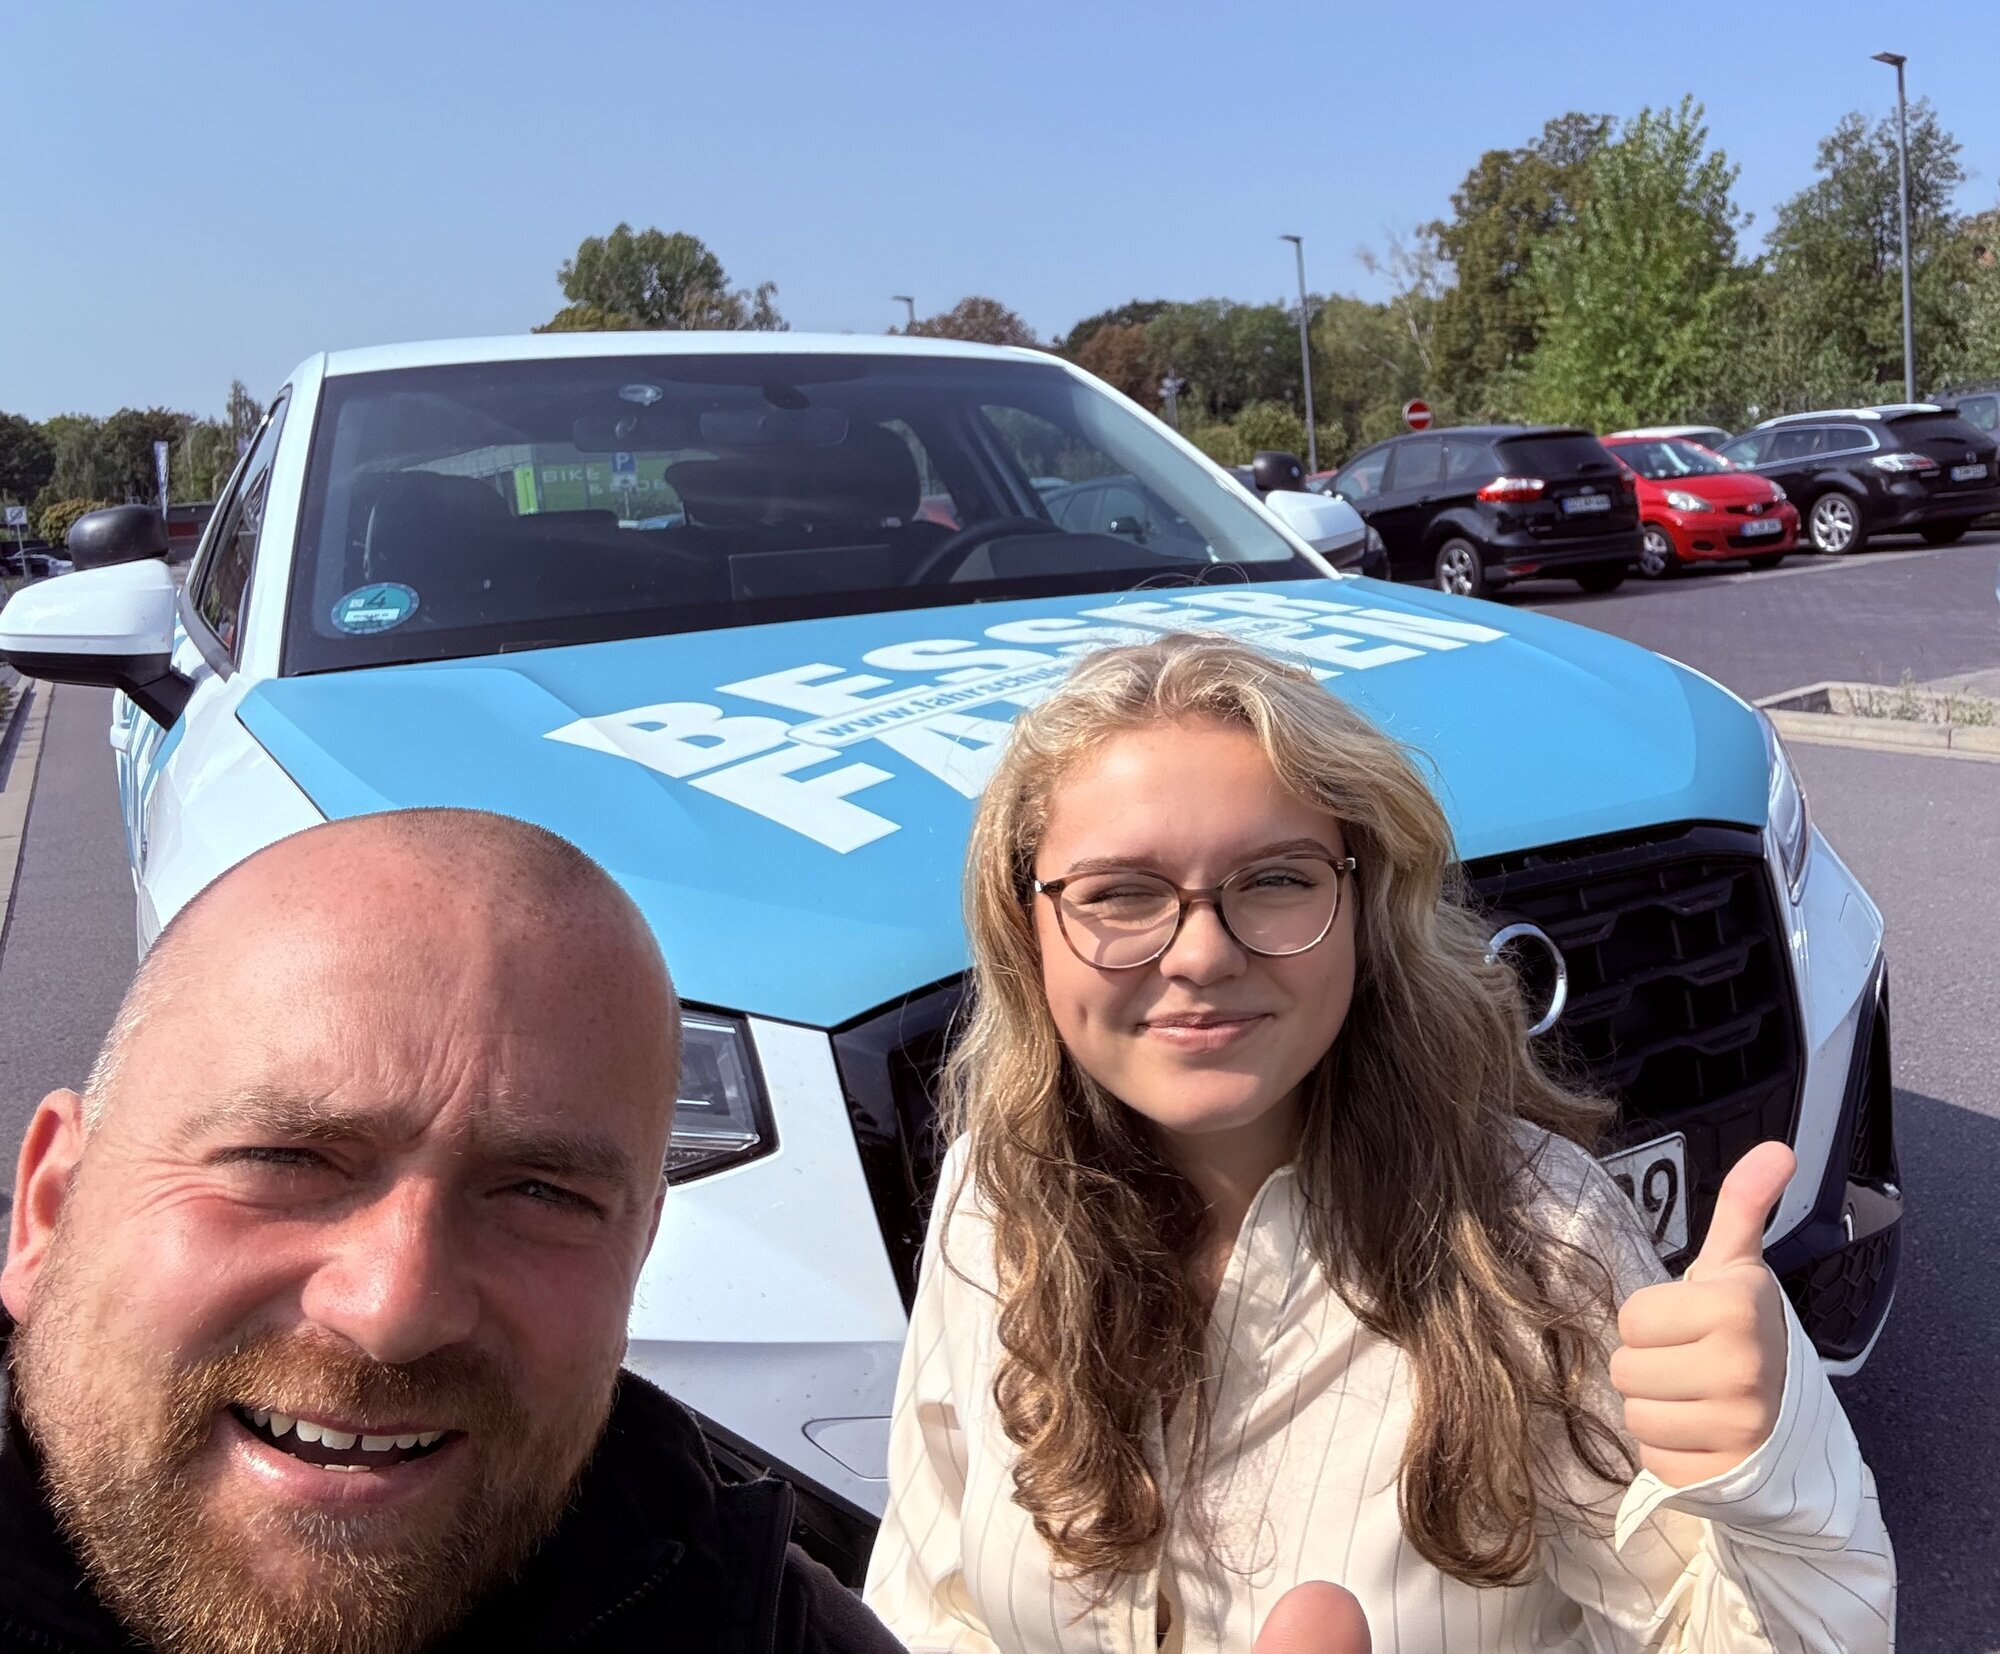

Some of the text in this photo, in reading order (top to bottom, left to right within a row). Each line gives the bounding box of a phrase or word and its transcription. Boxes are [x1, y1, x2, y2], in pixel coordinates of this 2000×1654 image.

[615, 452, 630, 471] P
[542, 467, 600, 483] BIKE
[367, 589, 387, 609] 4
[542, 591, 1364, 778] BESSER
[687, 608, 1511, 854] FAEN
